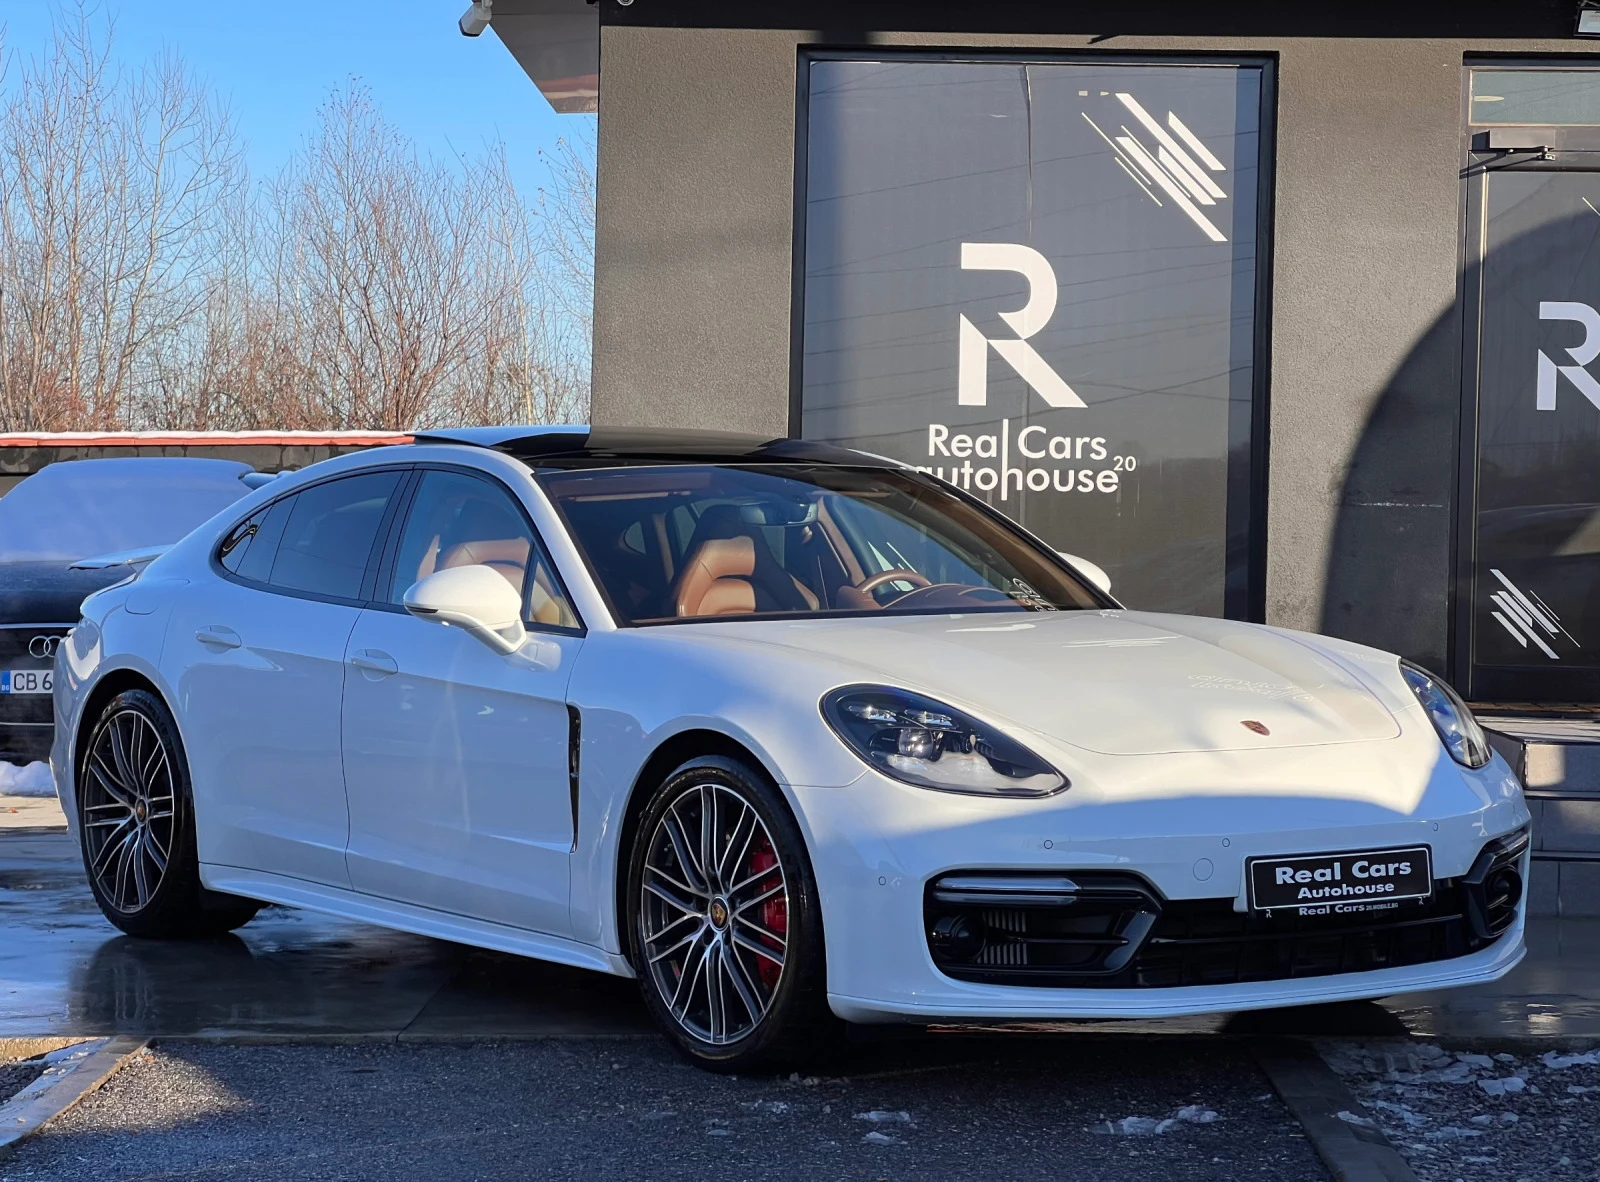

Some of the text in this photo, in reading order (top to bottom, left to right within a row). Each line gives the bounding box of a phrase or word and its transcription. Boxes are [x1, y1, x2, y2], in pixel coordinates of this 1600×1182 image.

[928, 419, 1108, 461] Real Cars
[1275, 860, 1412, 885] Real Cars
[1298, 883, 1395, 899] Autohouse
[1298, 905, 1331, 916] Real
[1334, 904, 1366, 913] Cars
